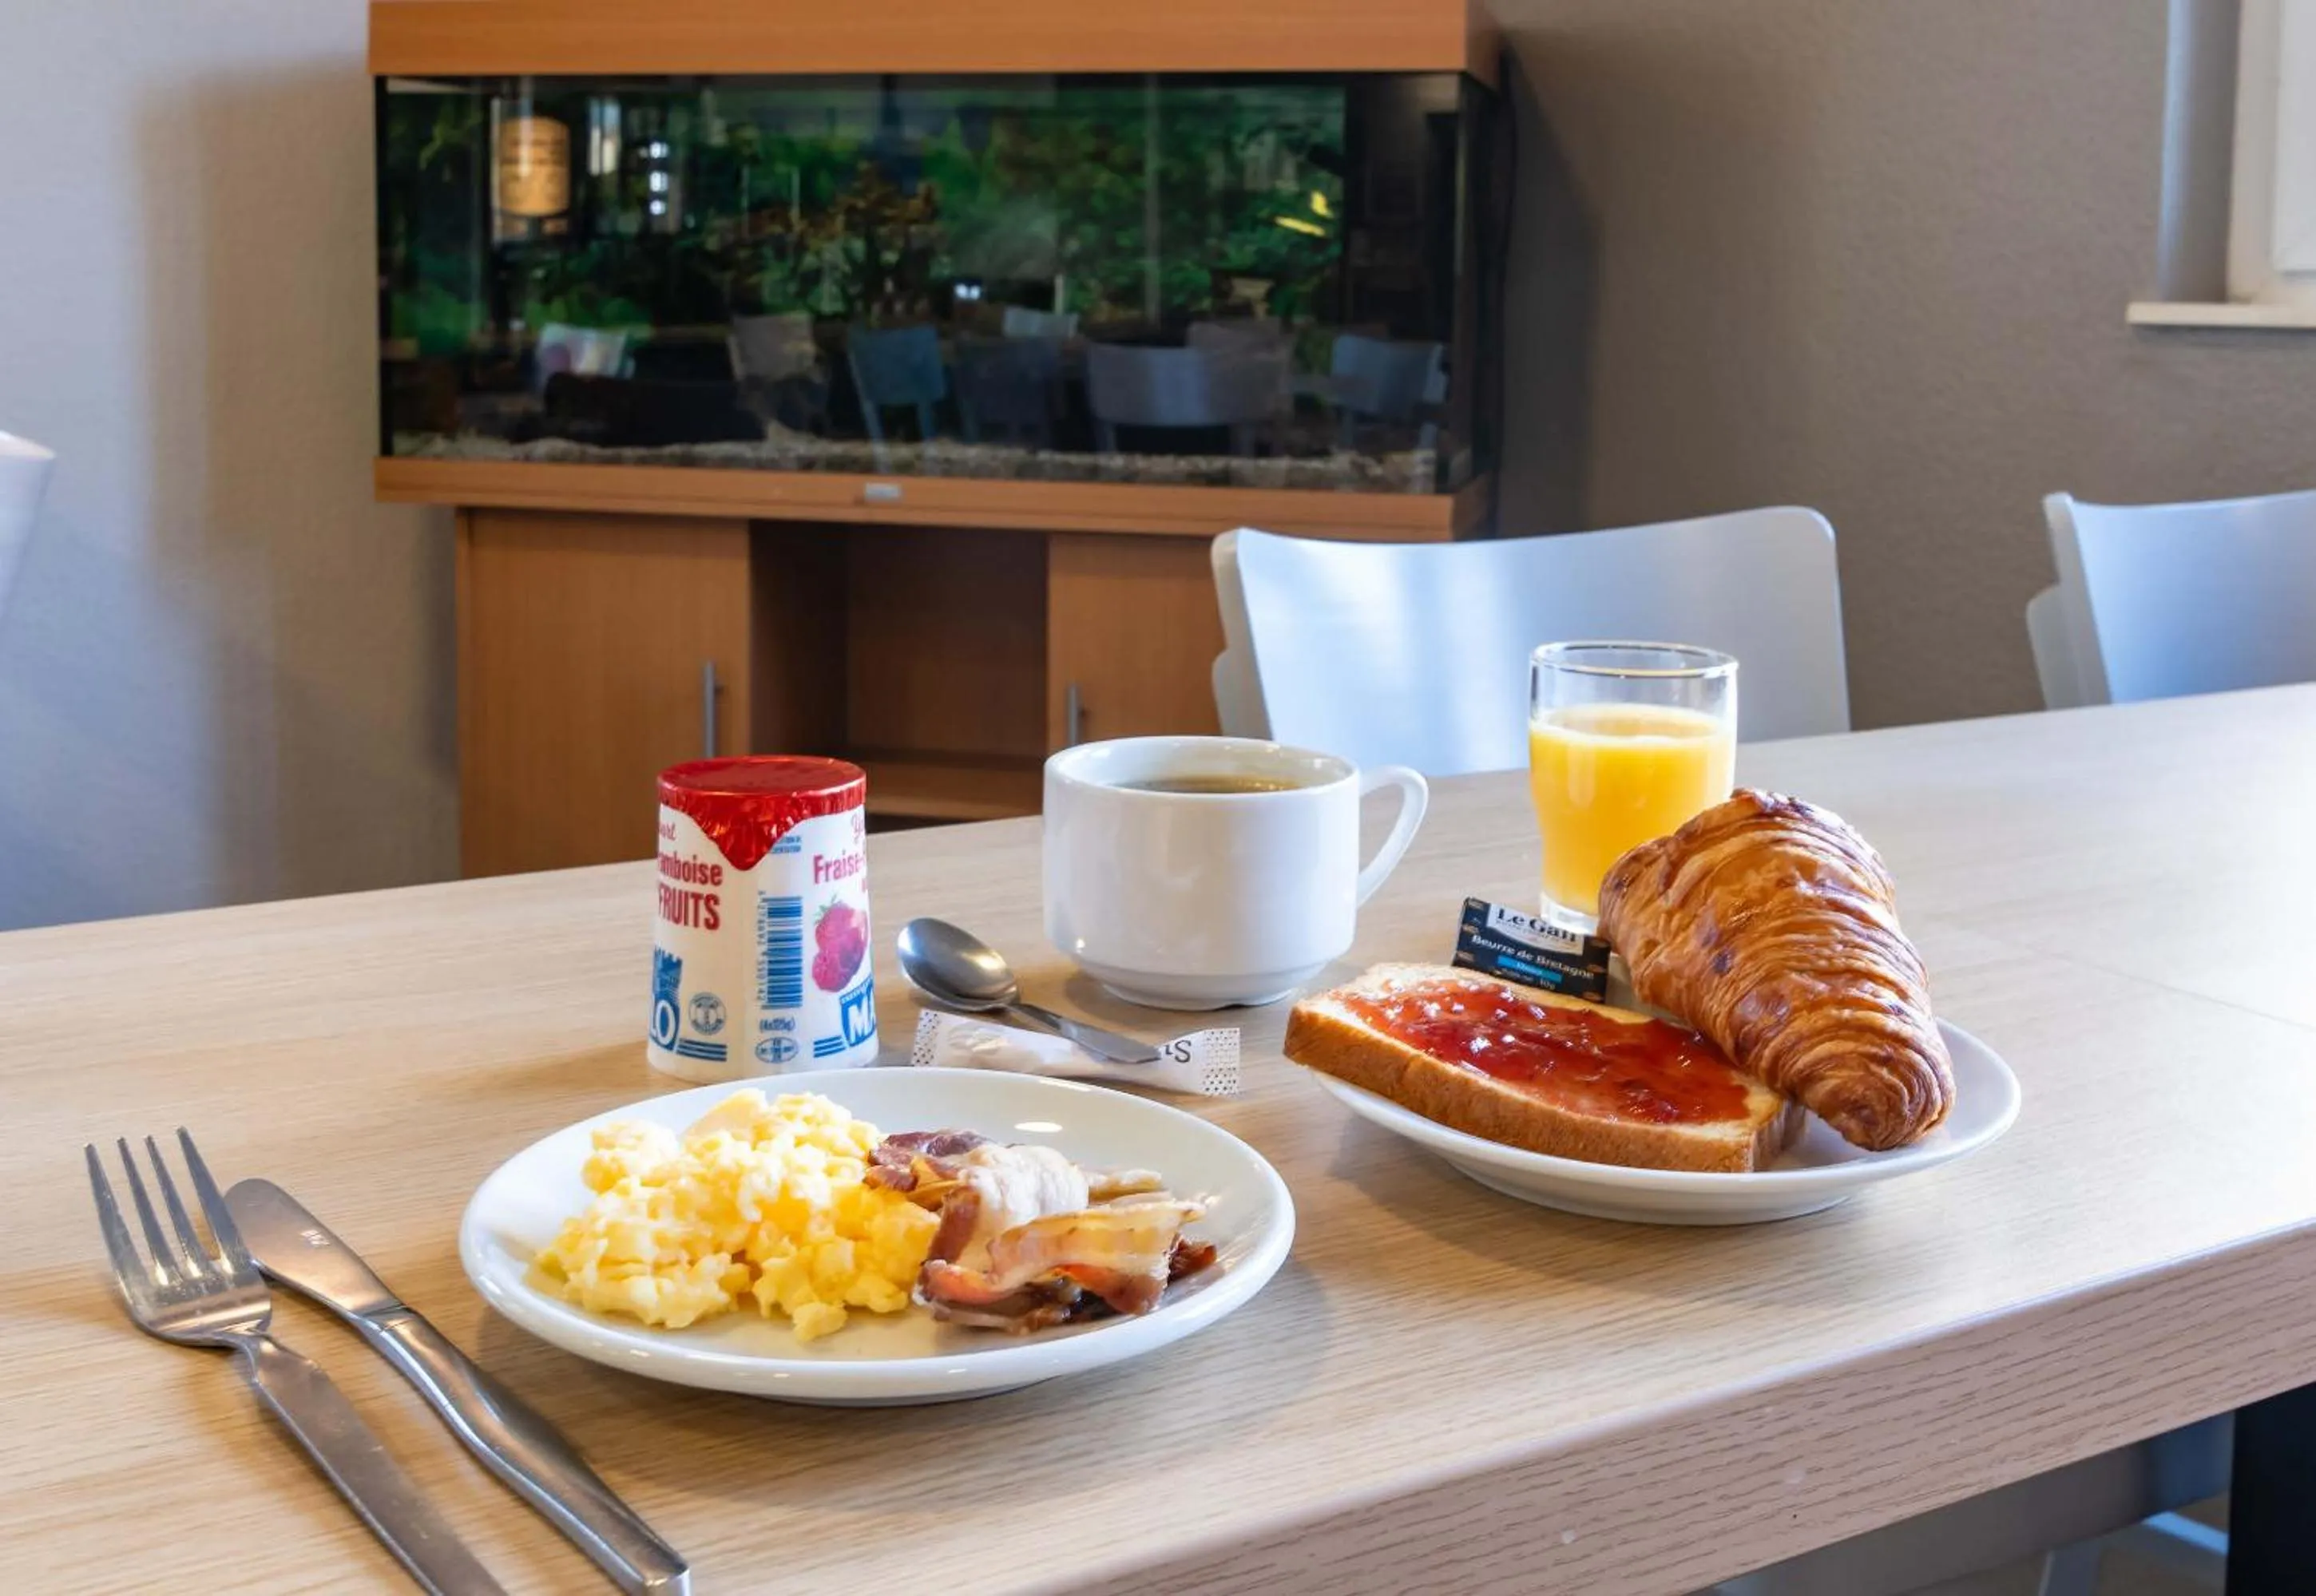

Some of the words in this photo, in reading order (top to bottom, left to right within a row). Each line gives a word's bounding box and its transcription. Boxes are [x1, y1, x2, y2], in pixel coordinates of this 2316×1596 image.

[1471, 934, 1516, 956] Beurre
[1517, 948, 1534, 961] de
[1537, 954, 1594, 980] Bretagne
